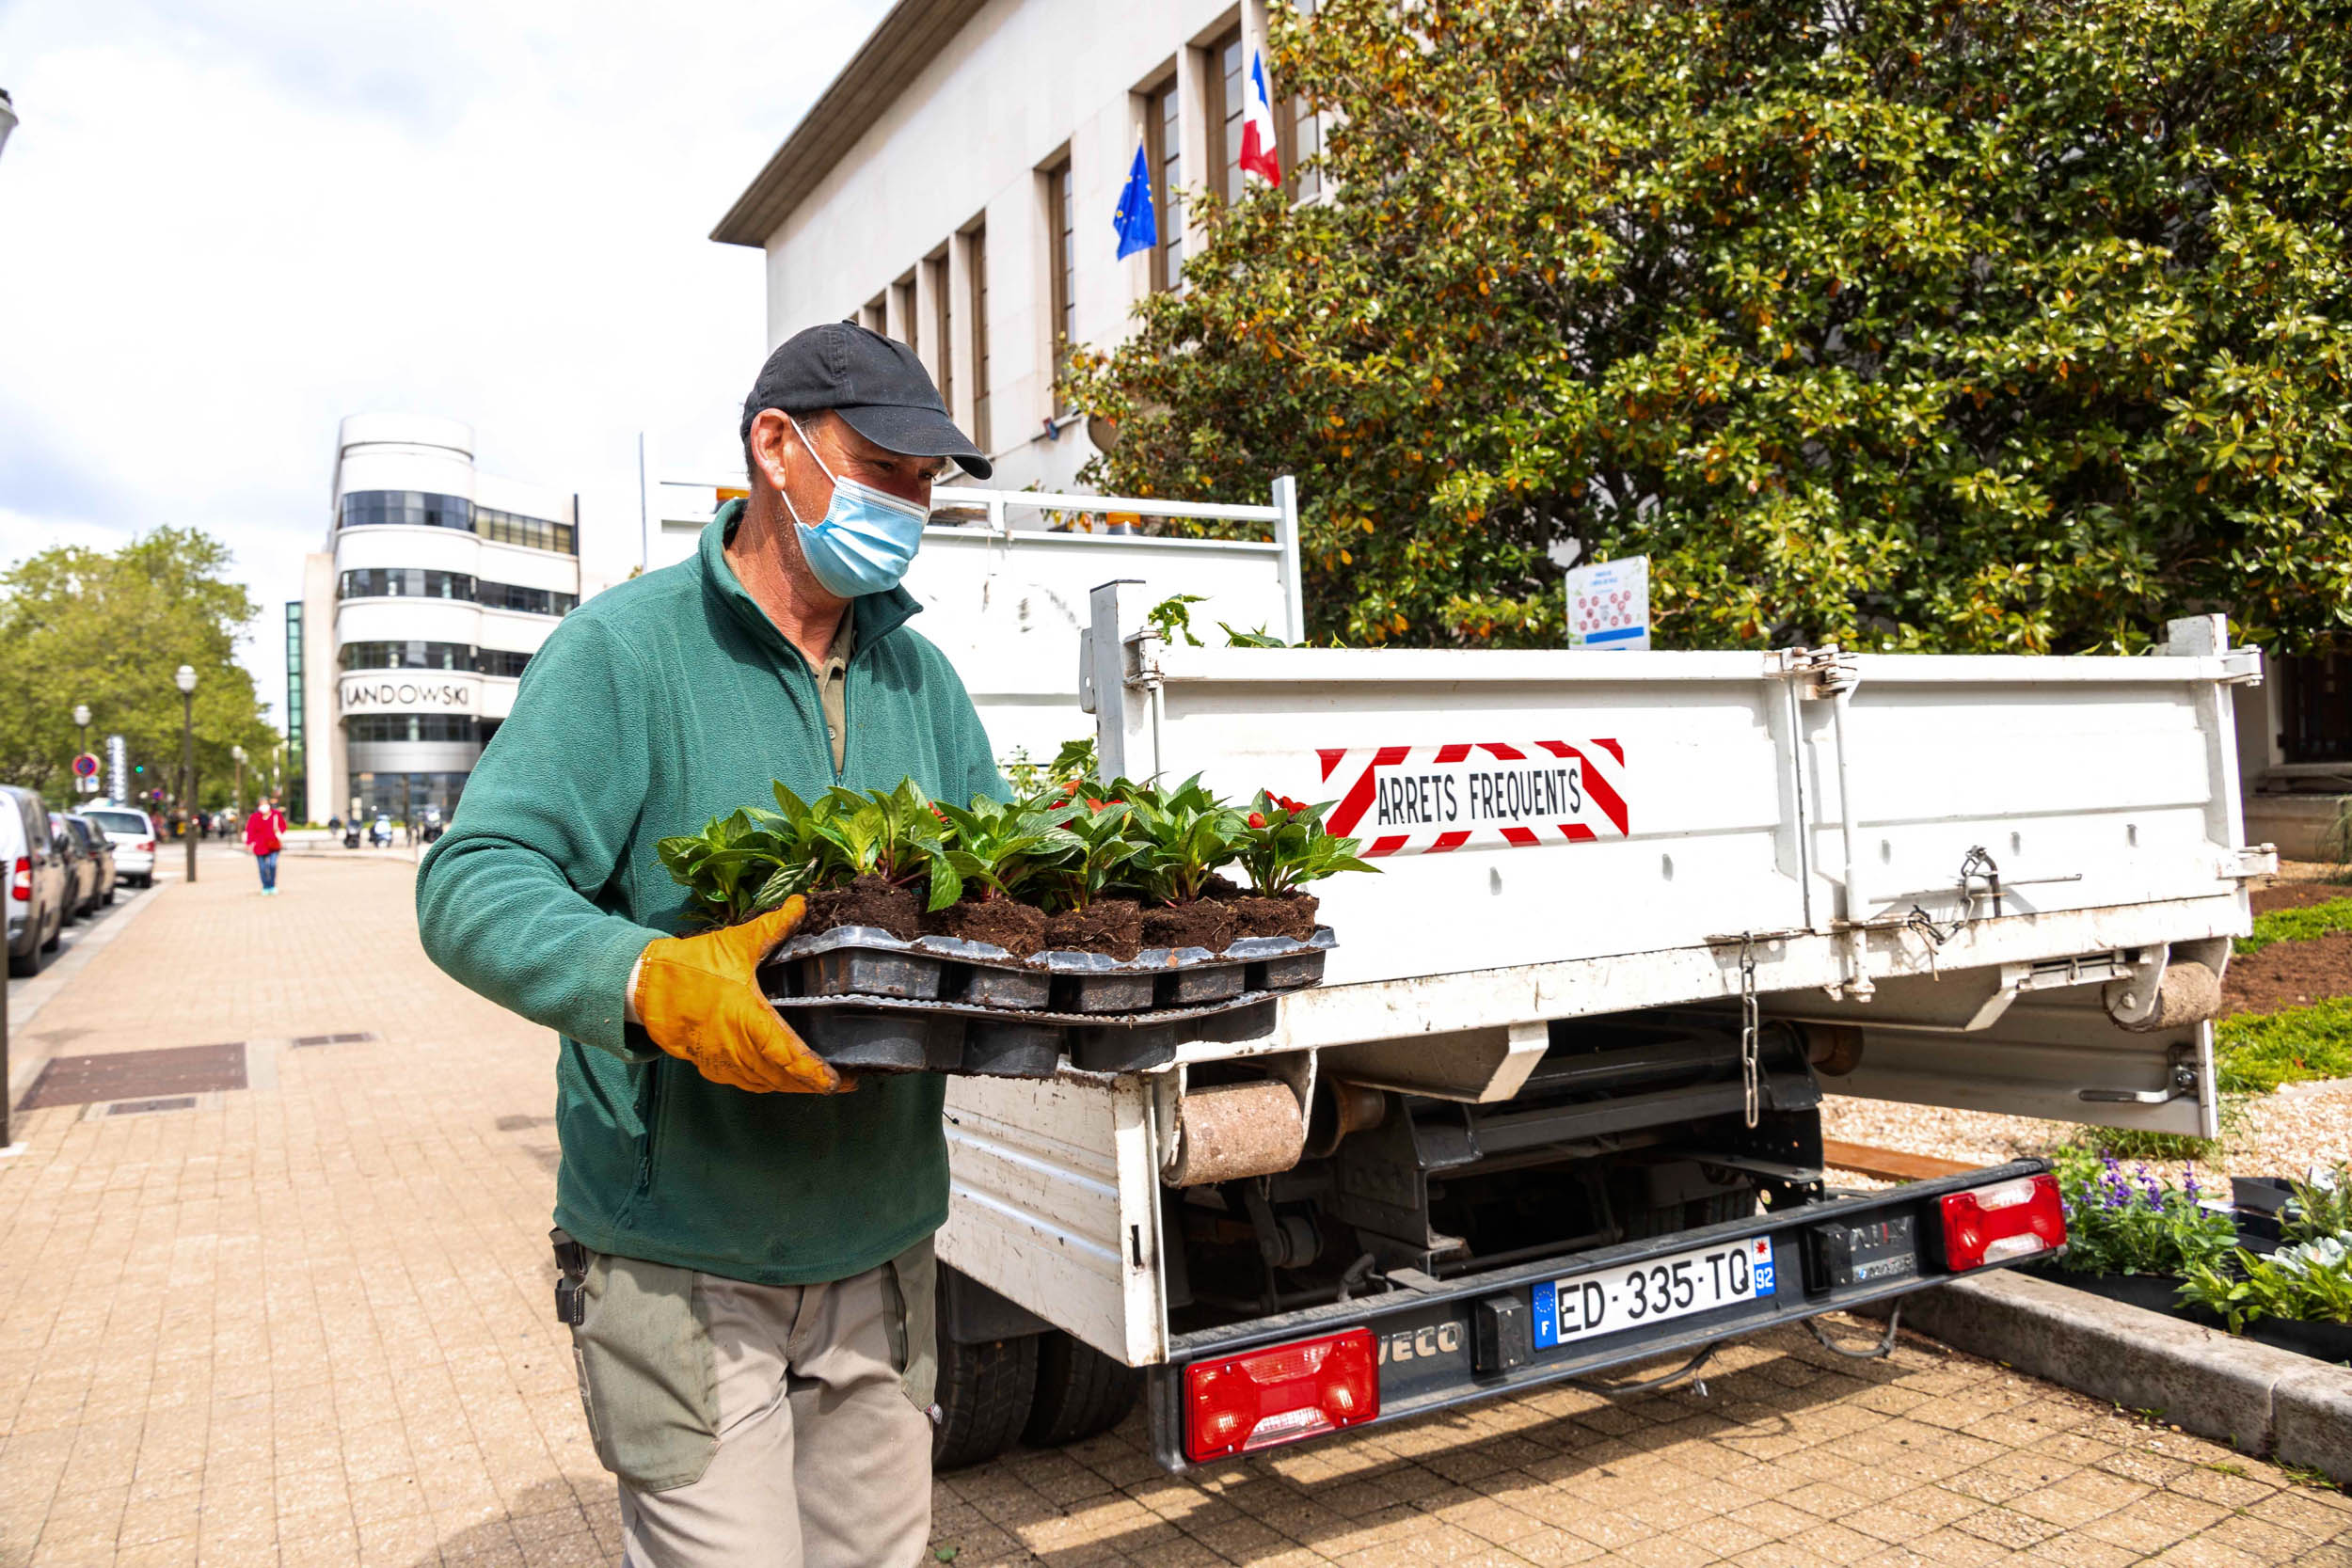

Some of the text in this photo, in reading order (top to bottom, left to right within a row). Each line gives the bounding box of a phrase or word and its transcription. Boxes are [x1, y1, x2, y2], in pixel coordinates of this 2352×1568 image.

[346, 685, 469, 705] LANDOWSKI
[1378, 768, 1581, 826] ARRETS FREQUENTS
[1541, 1248, 1773, 1337] F ED-335-TQ 92
